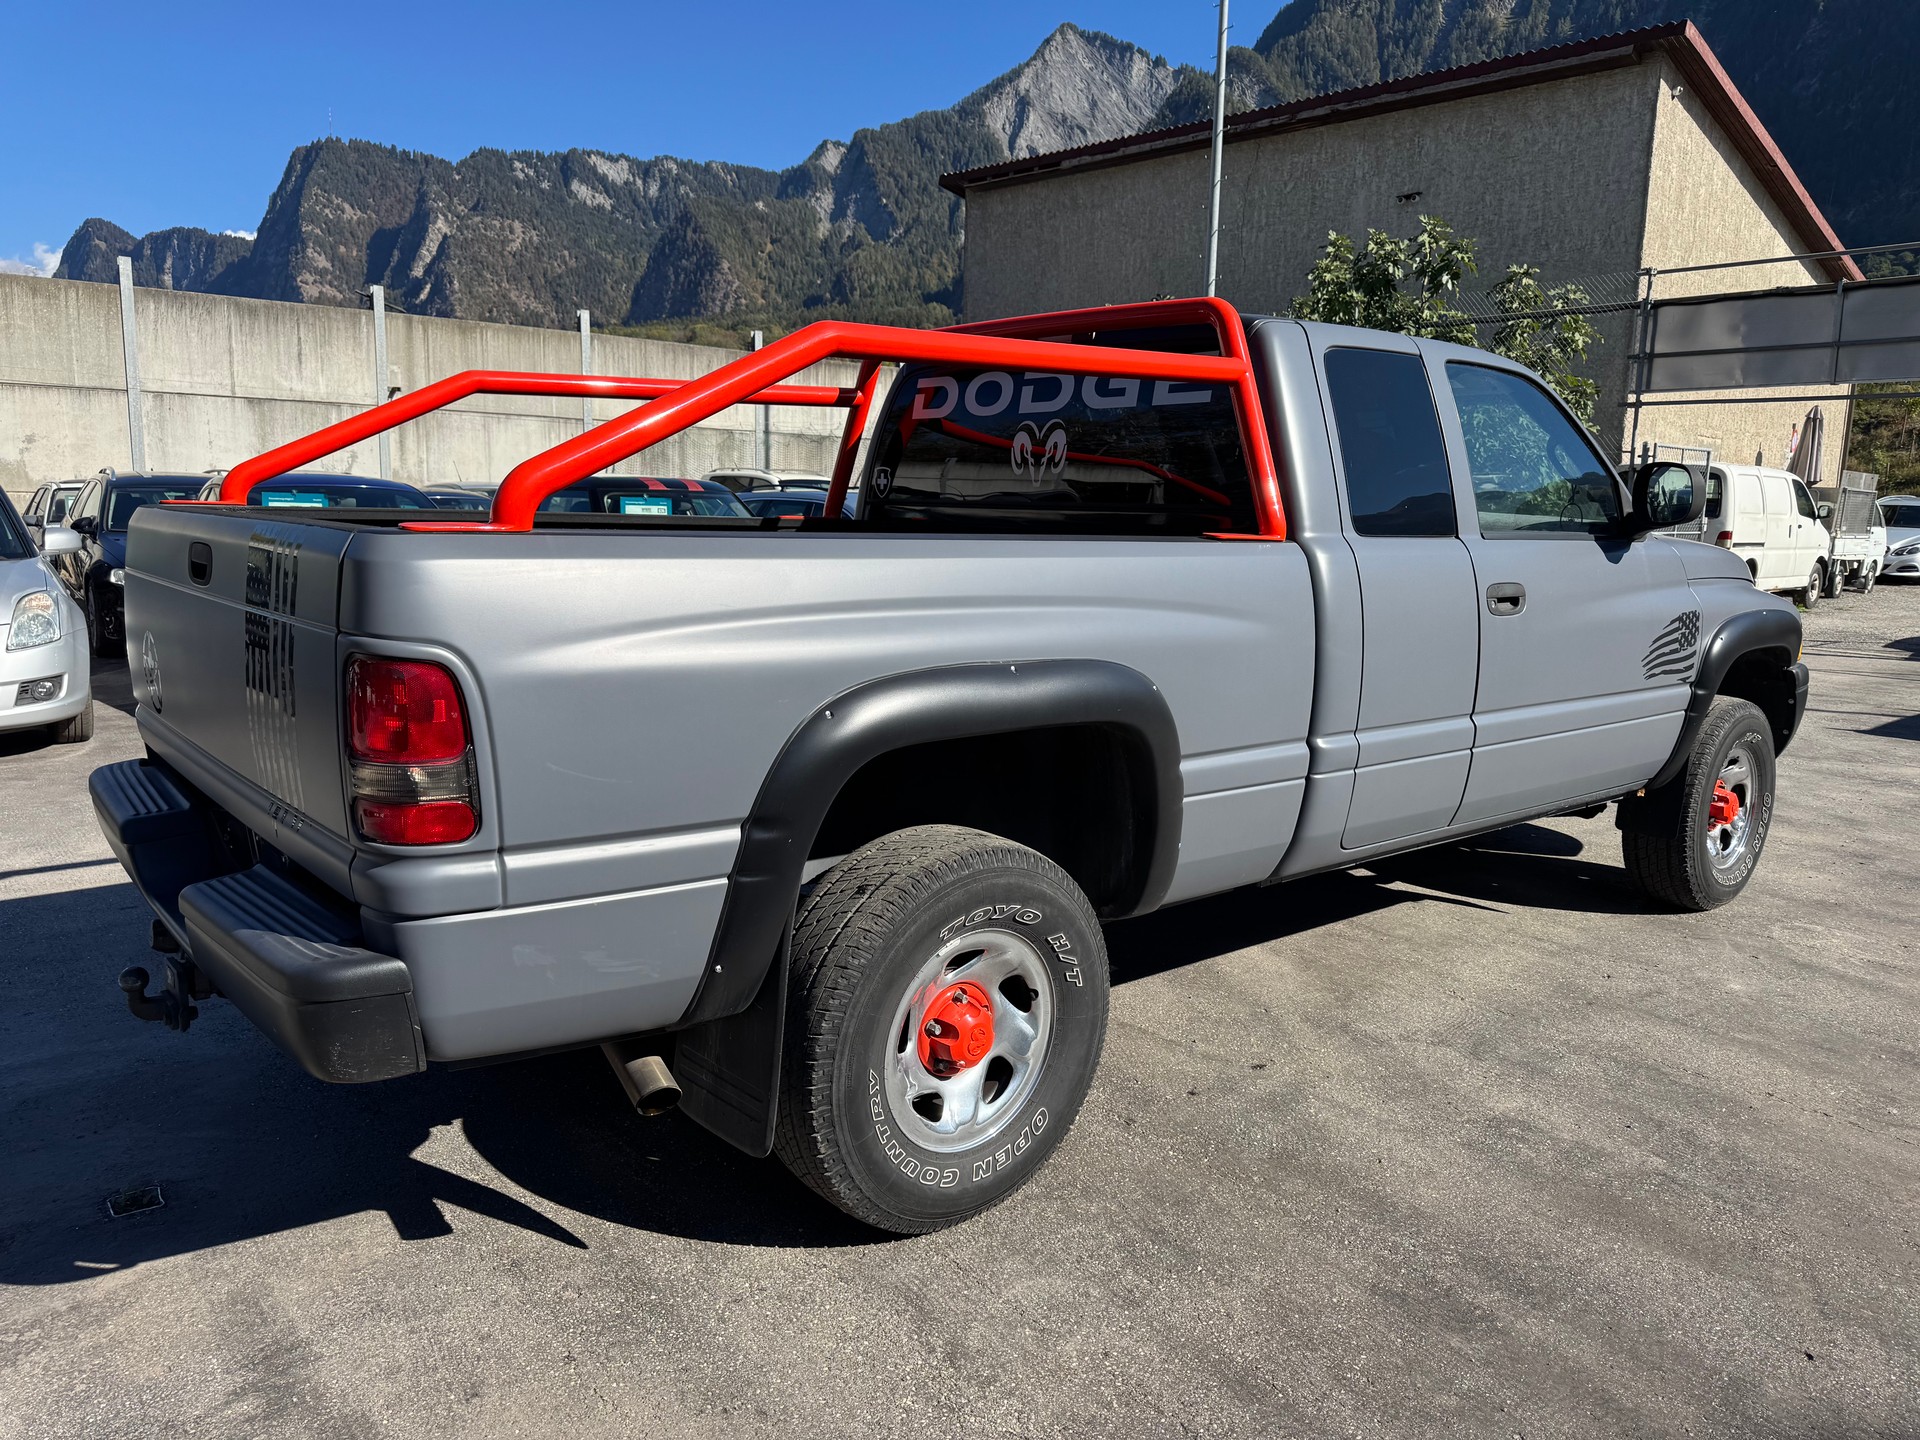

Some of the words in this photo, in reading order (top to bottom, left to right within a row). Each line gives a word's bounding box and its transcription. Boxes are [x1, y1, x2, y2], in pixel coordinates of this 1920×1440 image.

[912, 371, 1213, 420] DODGE
[1752, 792, 1772, 853] OPEN
[939, 905, 1042, 941] TOYO
[1047, 933, 1083, 987] H/T
[869, 1069, 960, 1188] COUNTRY
[972, 1107, 1049, 1182] OPEN
